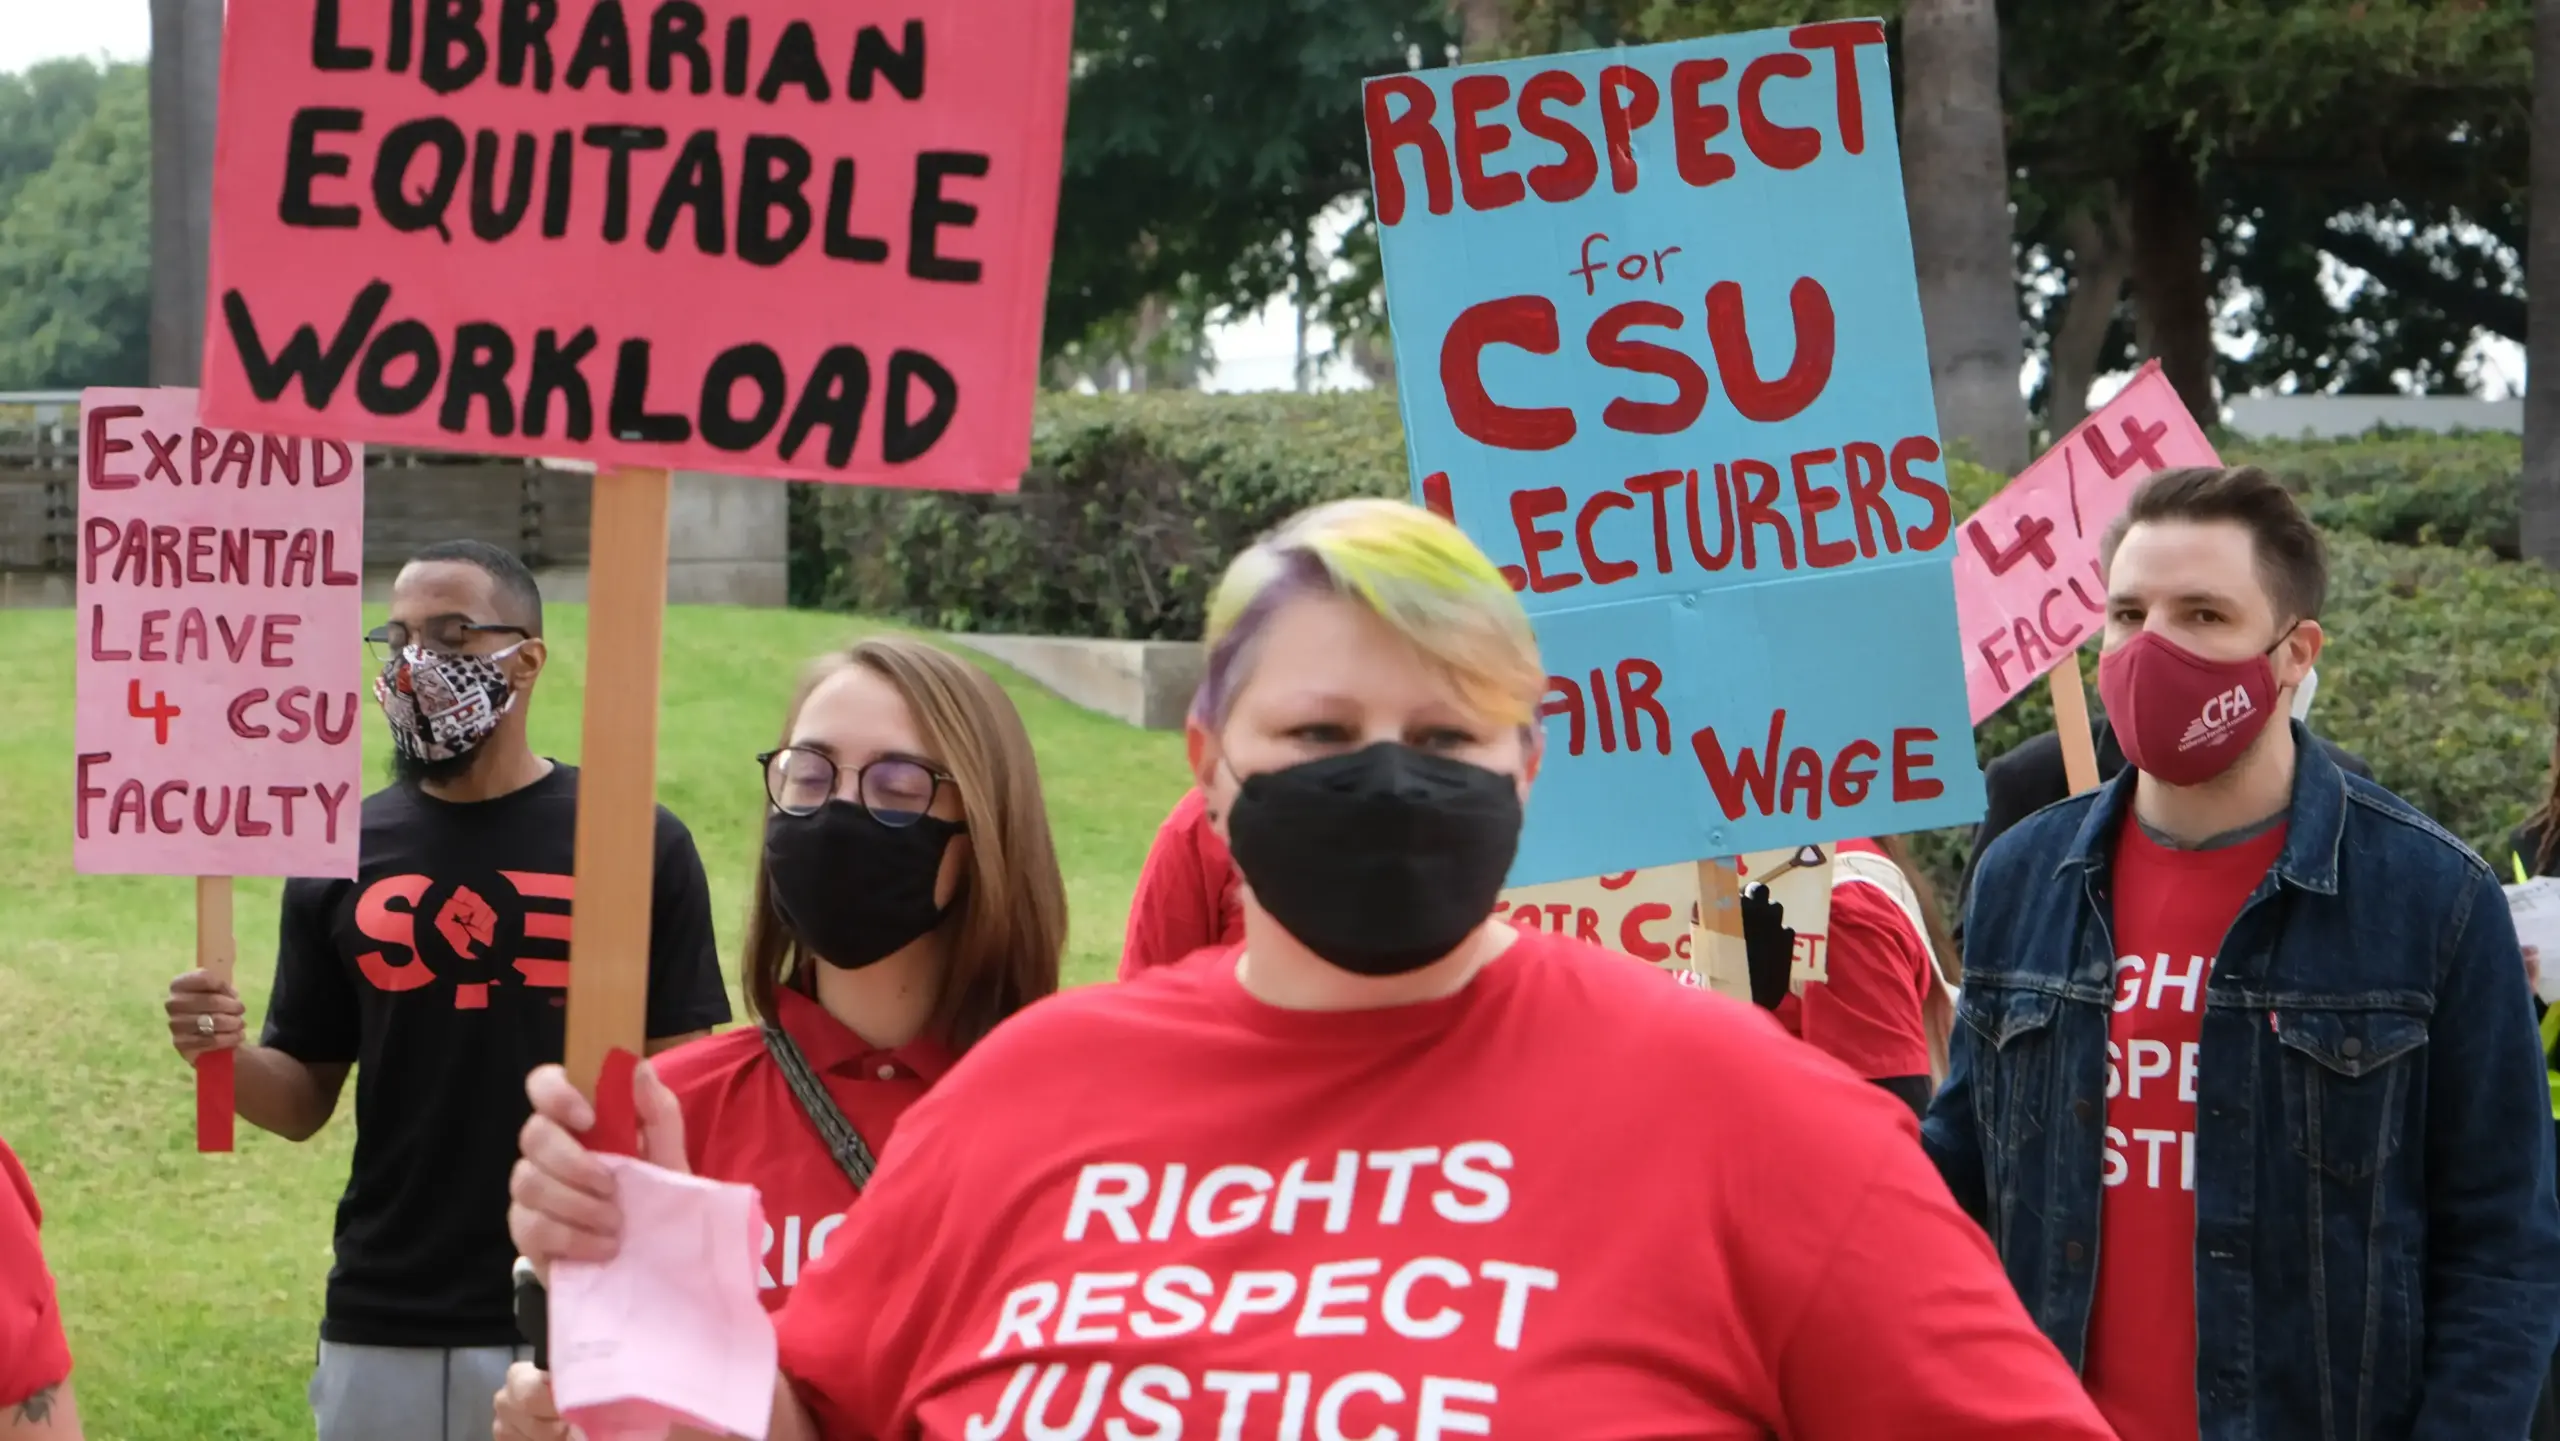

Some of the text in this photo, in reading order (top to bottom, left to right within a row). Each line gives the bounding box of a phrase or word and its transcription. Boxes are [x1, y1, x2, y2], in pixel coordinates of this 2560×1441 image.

[312, 0, 926, 104] LIBRARIAN
[1365, 21, 1885, 226] RESPECT
[278, 107, 991, 284] EQUITABLE
[1570, 233, 1682, 294] for
[222, 279, 958, 469] WORKLOAD
[1440, 277, 1836, 451] CSU
[86, 404, 355, 490] EXPAND
[1967, 415, 2169, 577] 4/4
[85, 517, 359, 588] PARENTAL
[92, 603, 302, 667] LEAVE
[127, 679, 358, 745] 4 CSU
[2202, 684, 2252, 729] CFA
[77, 751, 351, 844] FACULTY
[1691, 708, 1944, 822] WAGE
[2111, 952, 2217, 1014] GH
[1062, 1141, 1513, 1243] RIGHTS
[978, 1257, 1559, 1359] RESPECT
[964, 1362, 1498, 1441] JUSTICE
